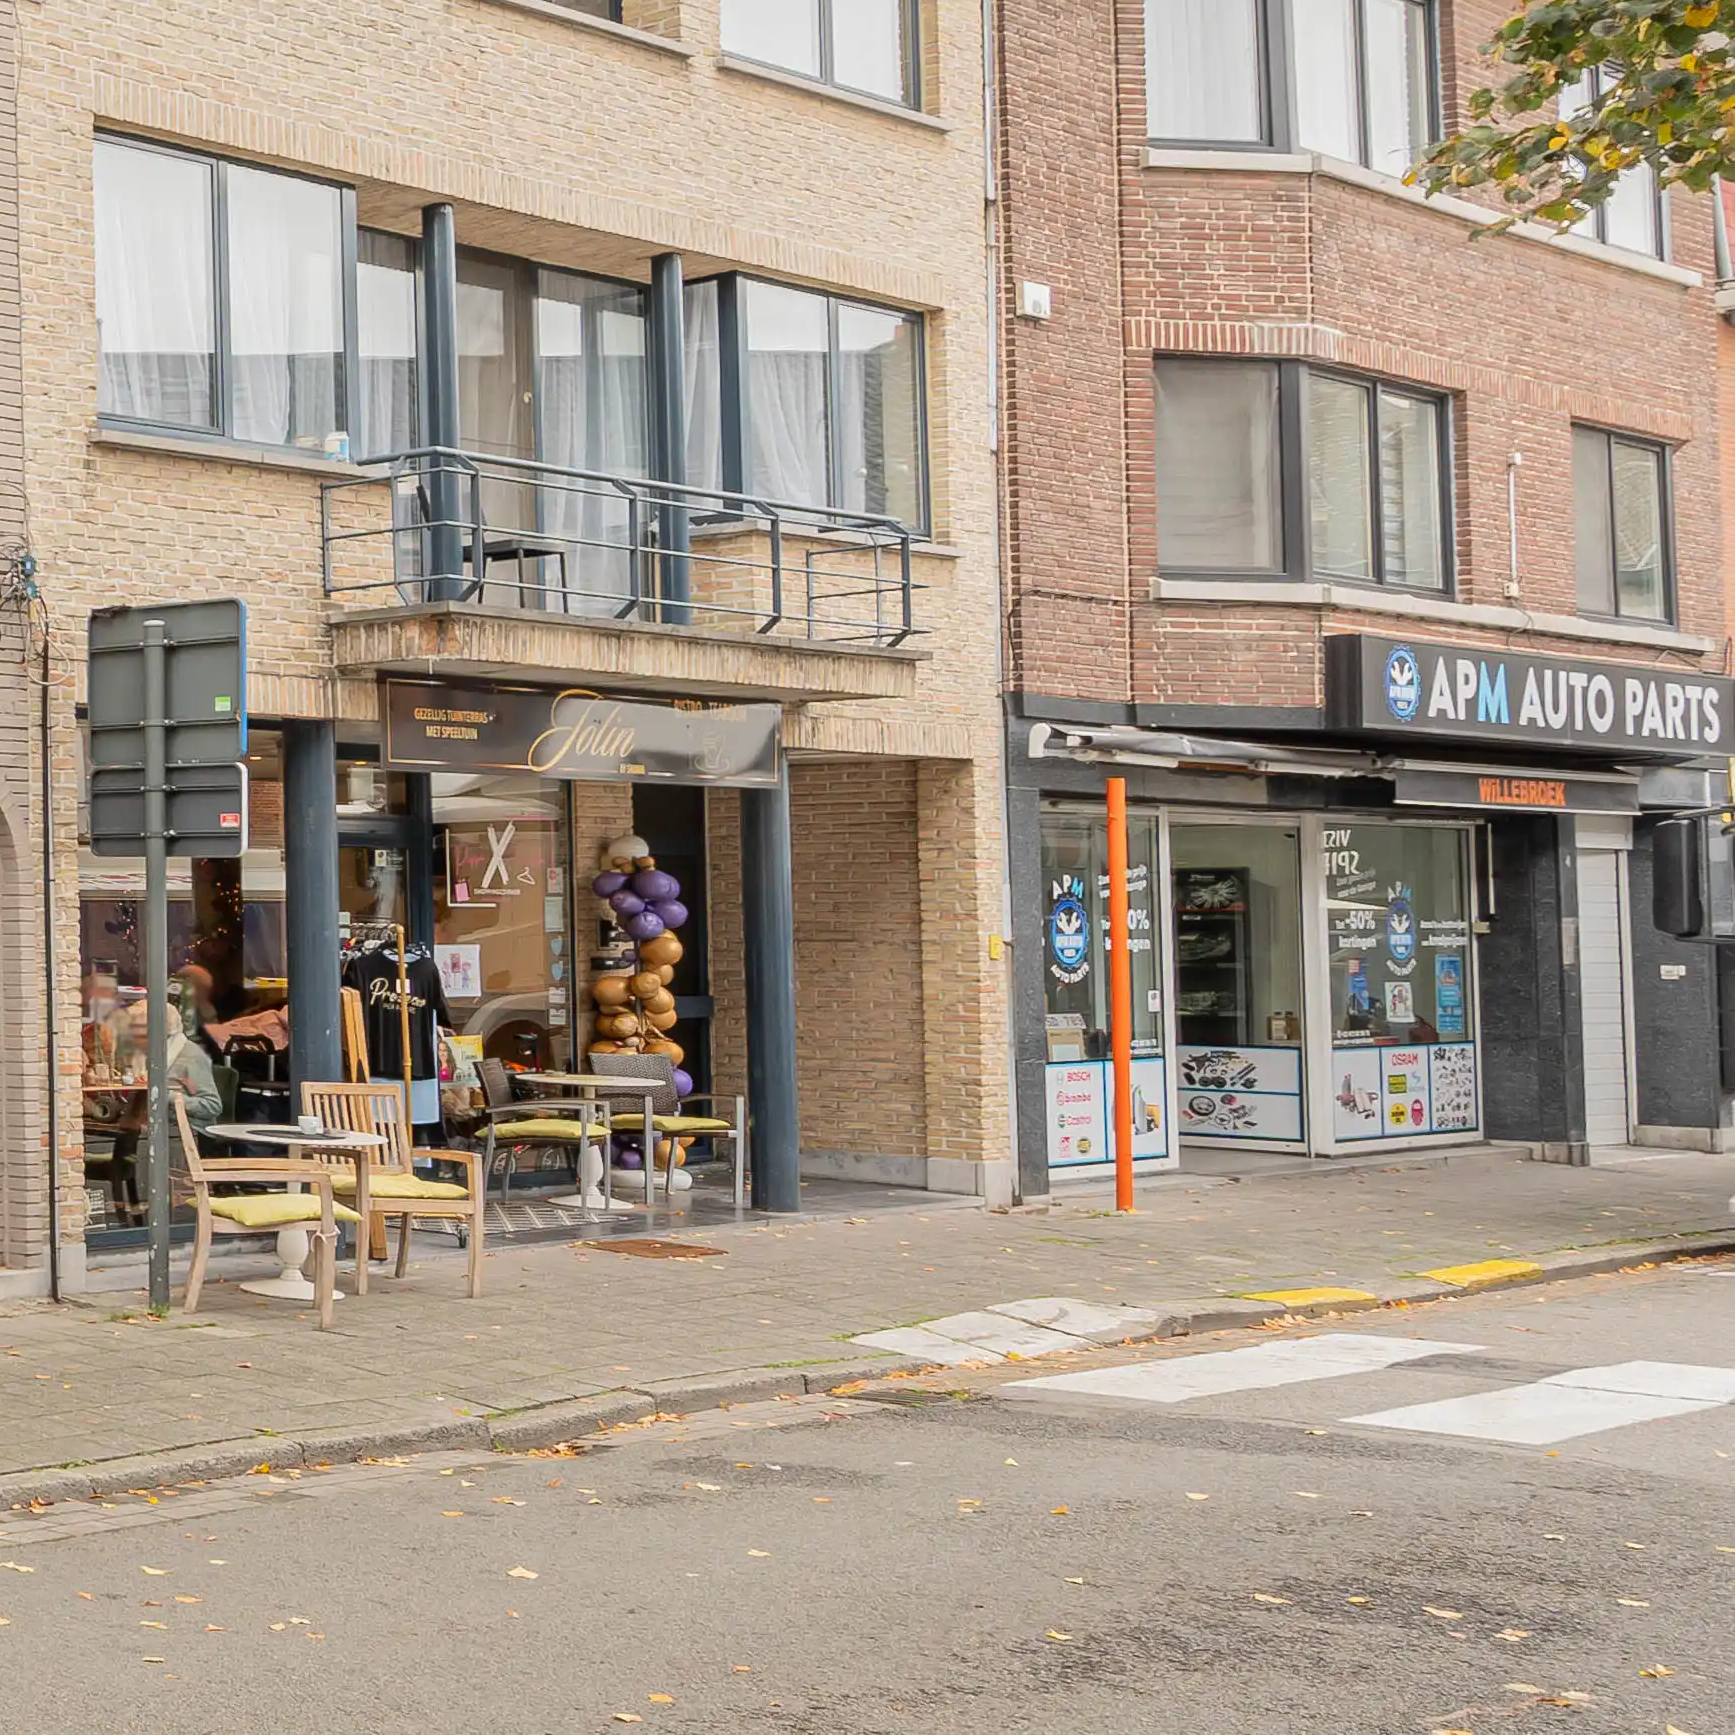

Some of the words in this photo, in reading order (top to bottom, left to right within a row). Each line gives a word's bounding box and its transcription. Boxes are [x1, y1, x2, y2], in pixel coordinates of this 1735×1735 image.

[1427, 656, 1510, 725] APM
[1518, 666, 1615, 734] AUTO
[1624, 677, 1720, 744] PARTS
[1052, 874, 1084, 900] APM
[1391, 1052, 1419, 1066] OSRAM
[1066, 1071, 1091, 1082] BOSCH
